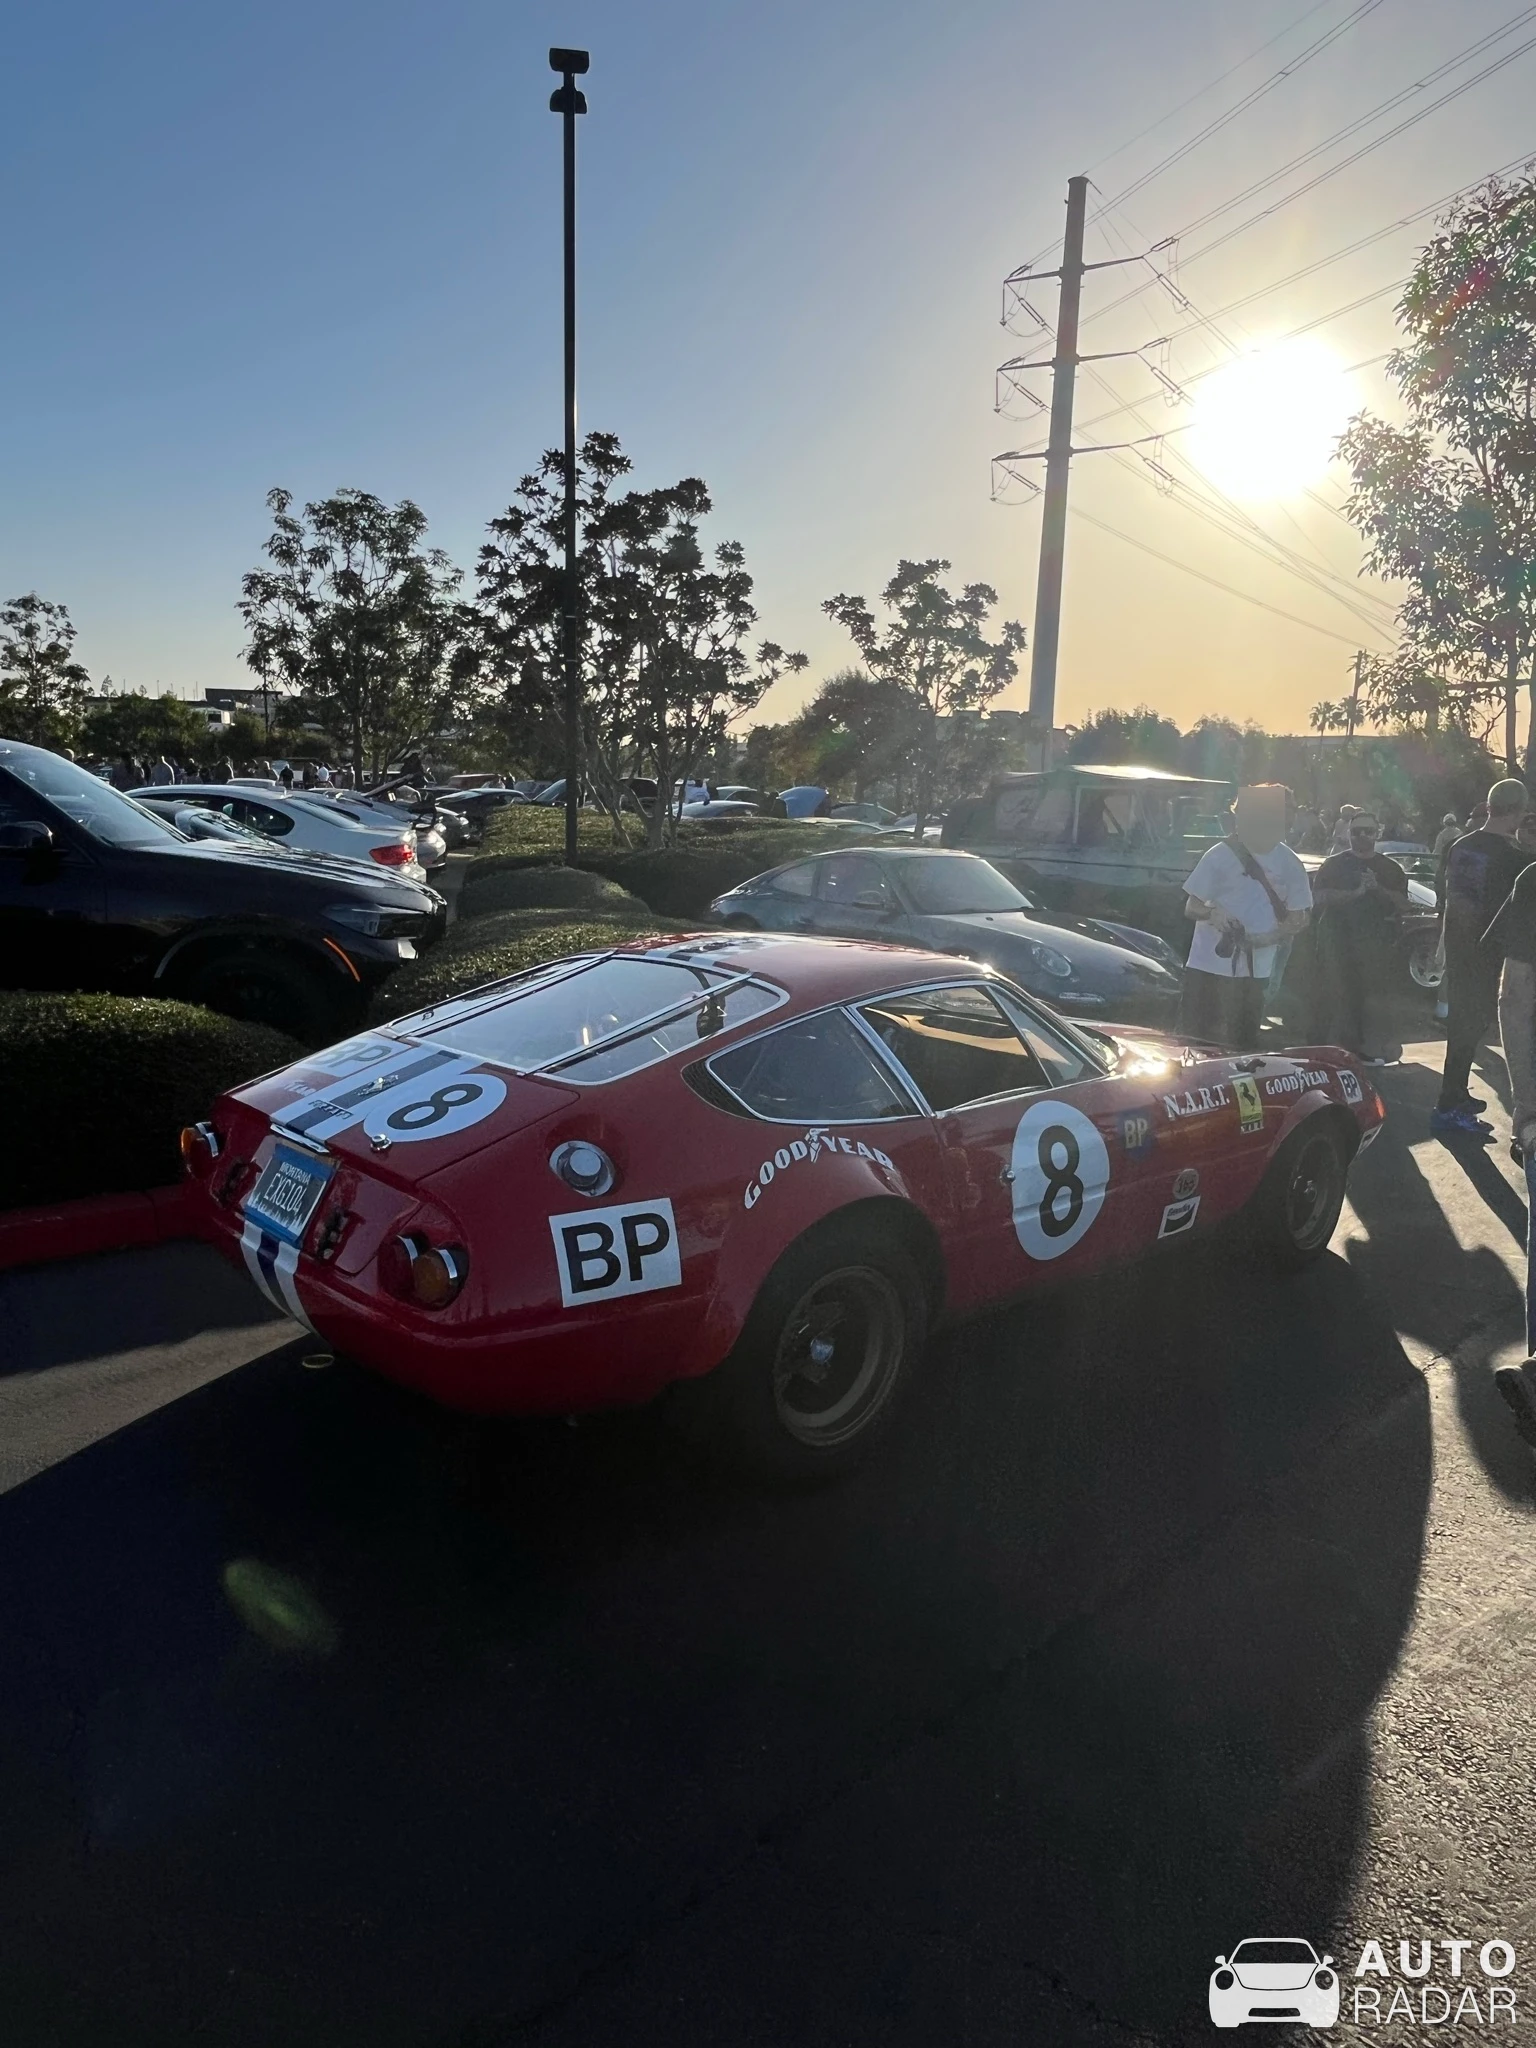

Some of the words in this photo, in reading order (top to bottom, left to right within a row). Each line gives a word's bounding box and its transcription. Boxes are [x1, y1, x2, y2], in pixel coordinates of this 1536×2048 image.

[1163, 1084, 1230, 1120] N.A.R.T.
[1265, 1070, 1330, 1095] GOODYEAR
[387, 1083, 483, 1130] 8
[1124, 1118, 1148, 1149] BP
[279, 1161, 312, 1185] MONTANA
[744, 1130, 895, 1209] GOODYEAR
[1038, 1125, 1084, 1238] 8
[561, 1212, 671, 1294] BP
